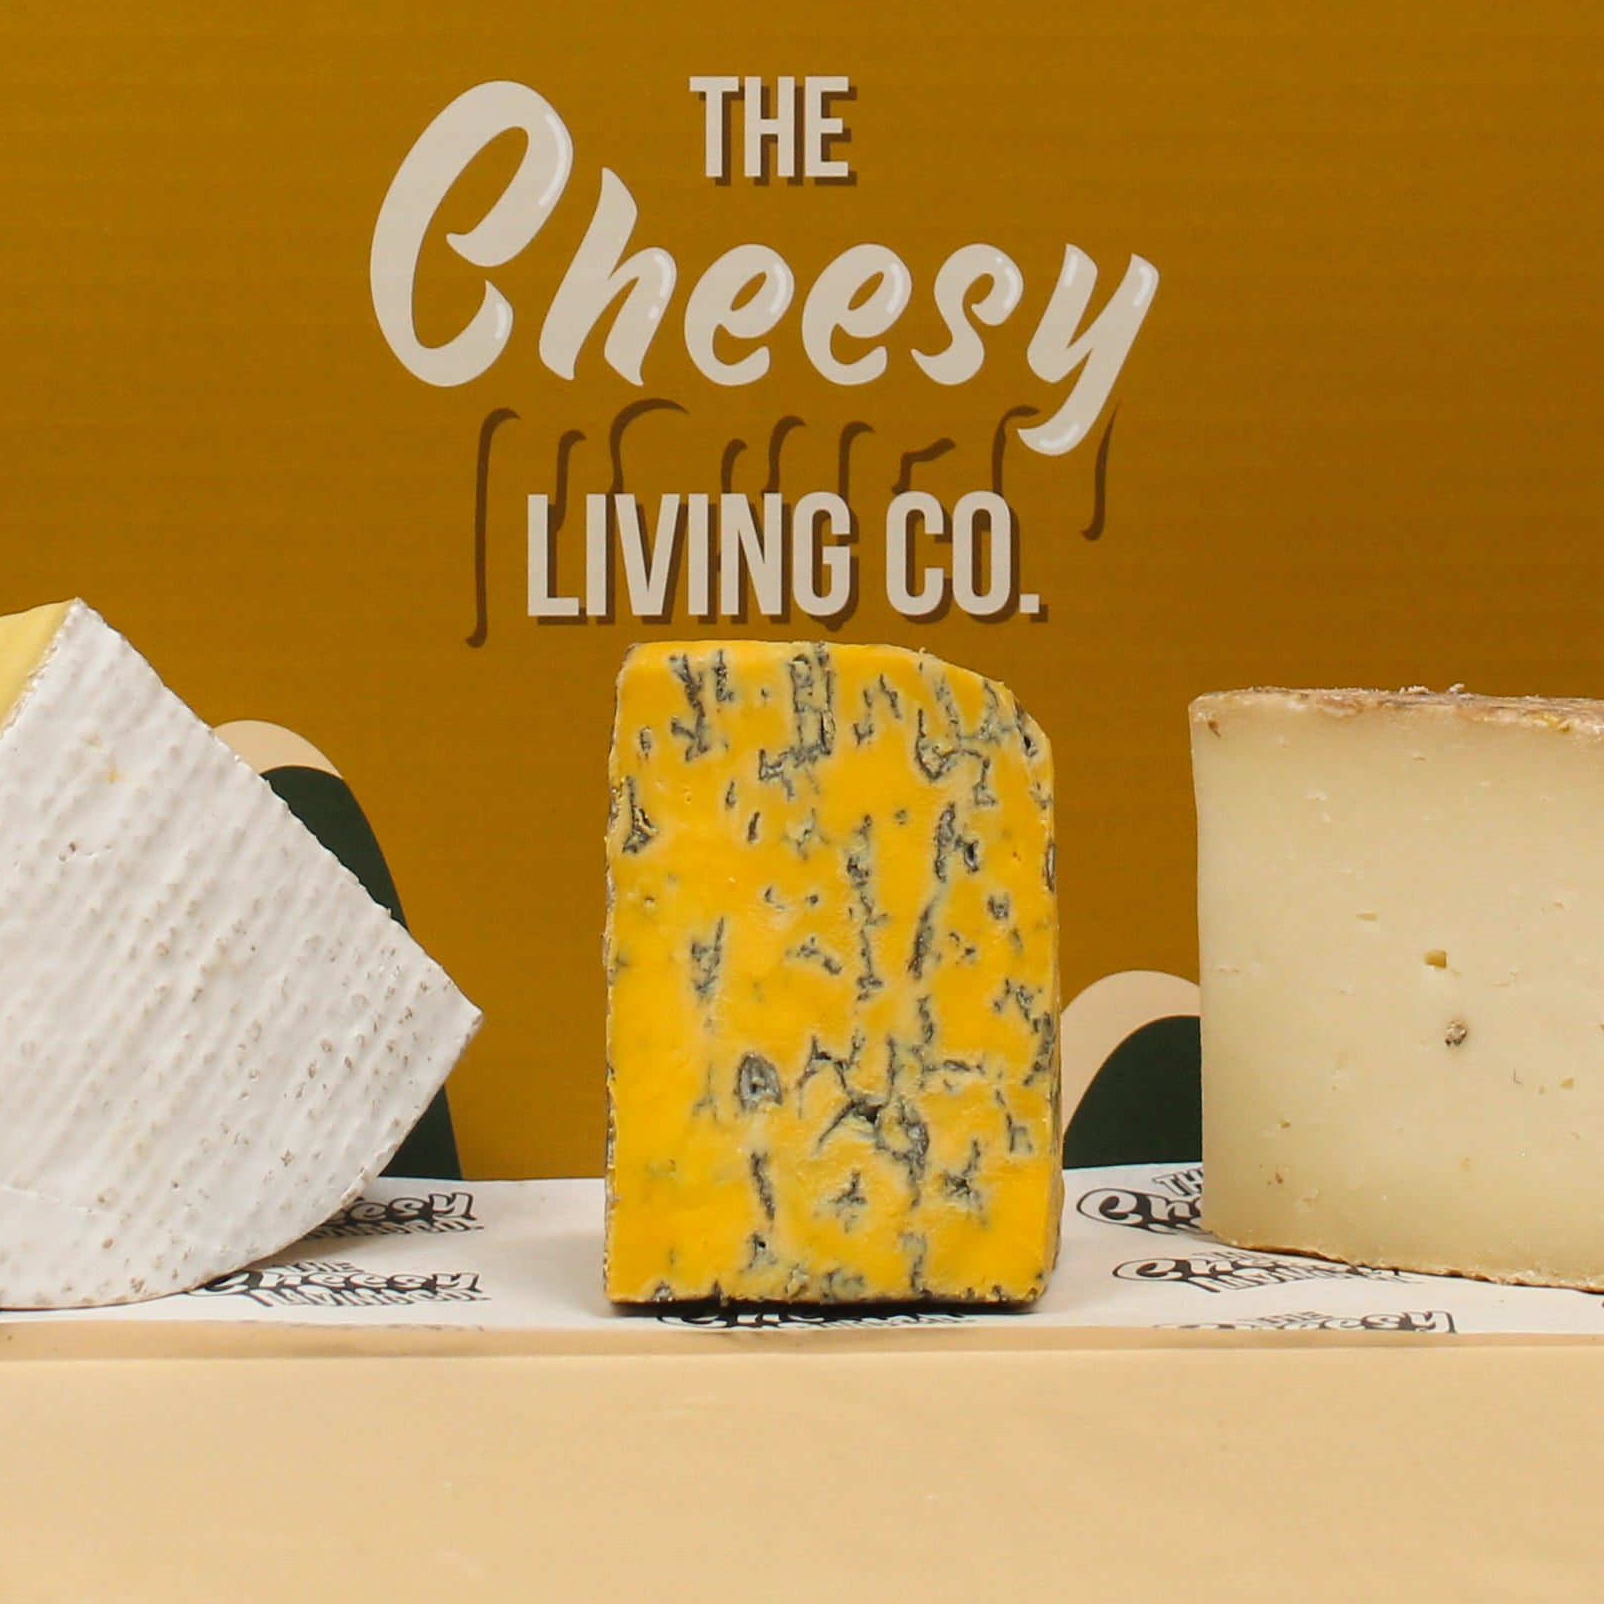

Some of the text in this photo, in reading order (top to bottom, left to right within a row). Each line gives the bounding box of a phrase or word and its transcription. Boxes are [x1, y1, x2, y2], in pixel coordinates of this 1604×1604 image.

[690, 76, 854, 181] THE
[370, 80, 1159, 455] Cheesy
[527, 490, 1041, 618] LIVING CO.
[1152, 1169, 1203, 1197] TH
